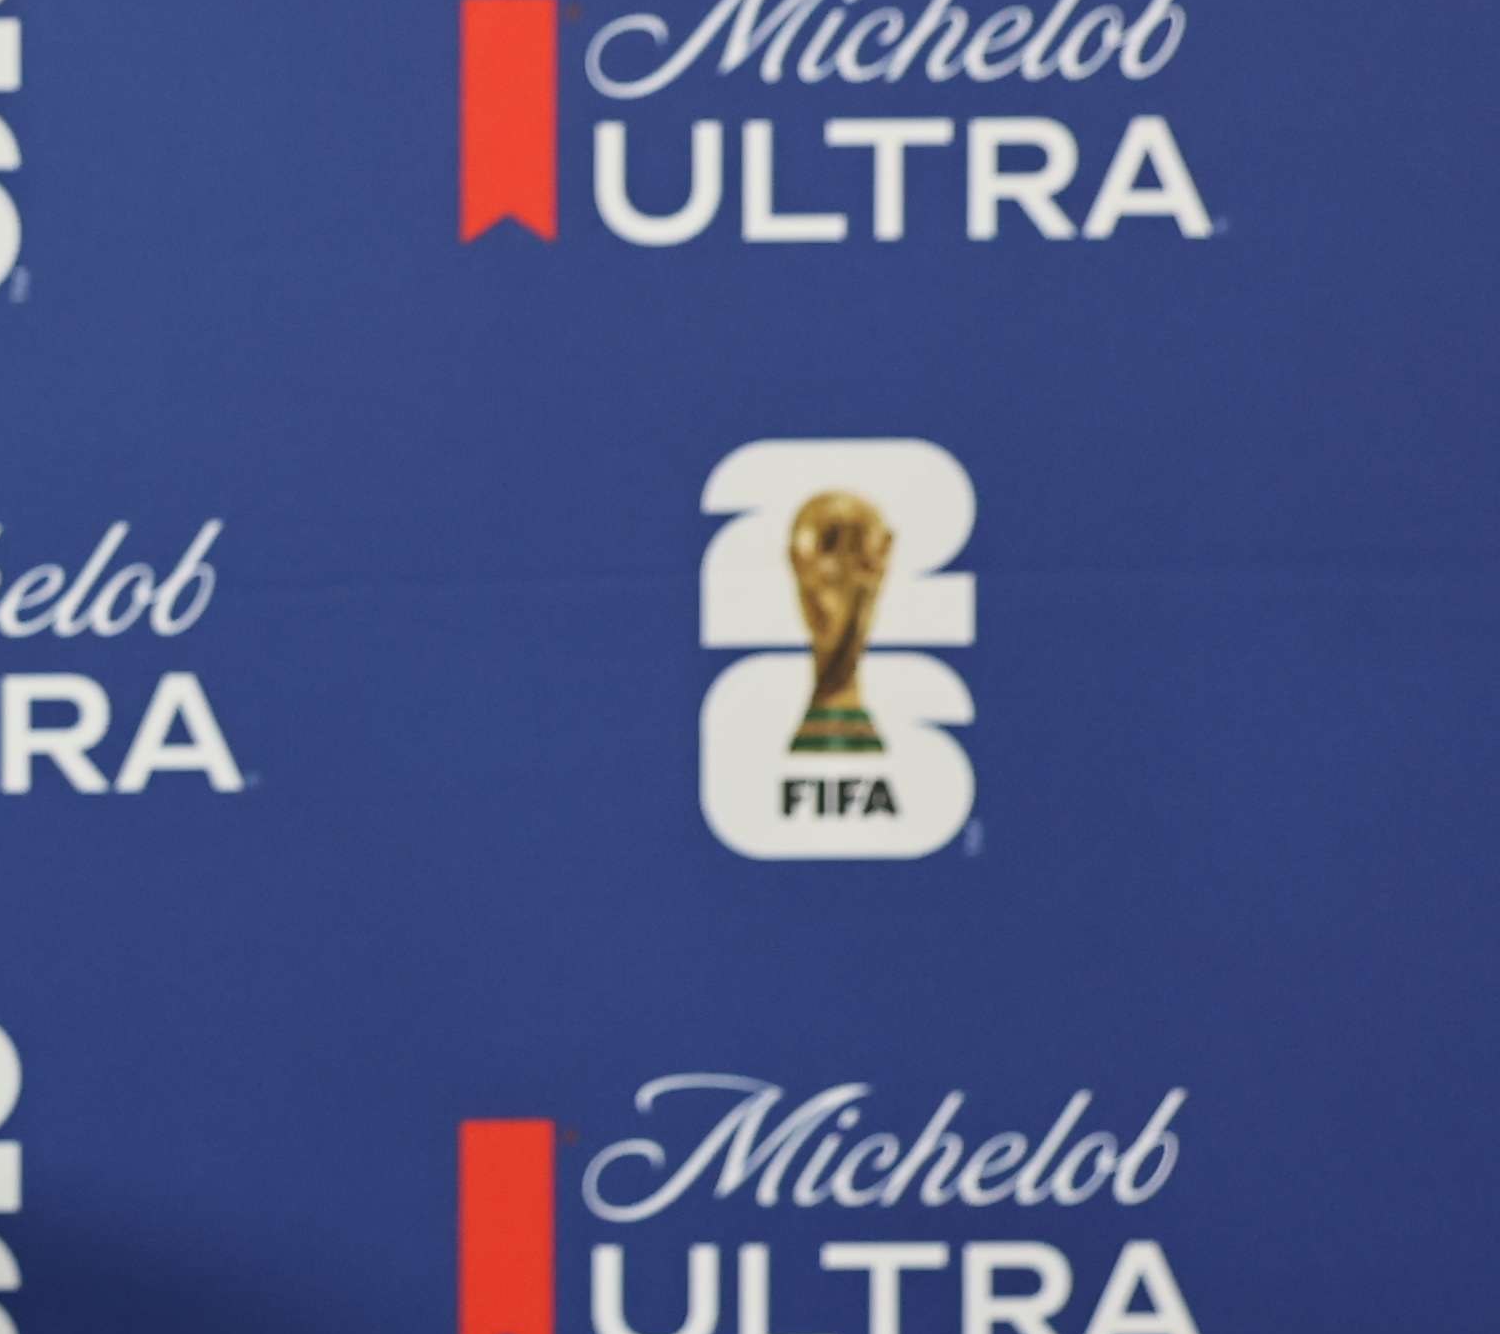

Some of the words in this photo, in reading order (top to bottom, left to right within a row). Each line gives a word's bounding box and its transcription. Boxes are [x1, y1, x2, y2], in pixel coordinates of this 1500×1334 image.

[593, 115, 1214, 247] ULTRA
[779, 776, 900, 819] FIFA
[582, 1073, 1187, 1223] Michelob
